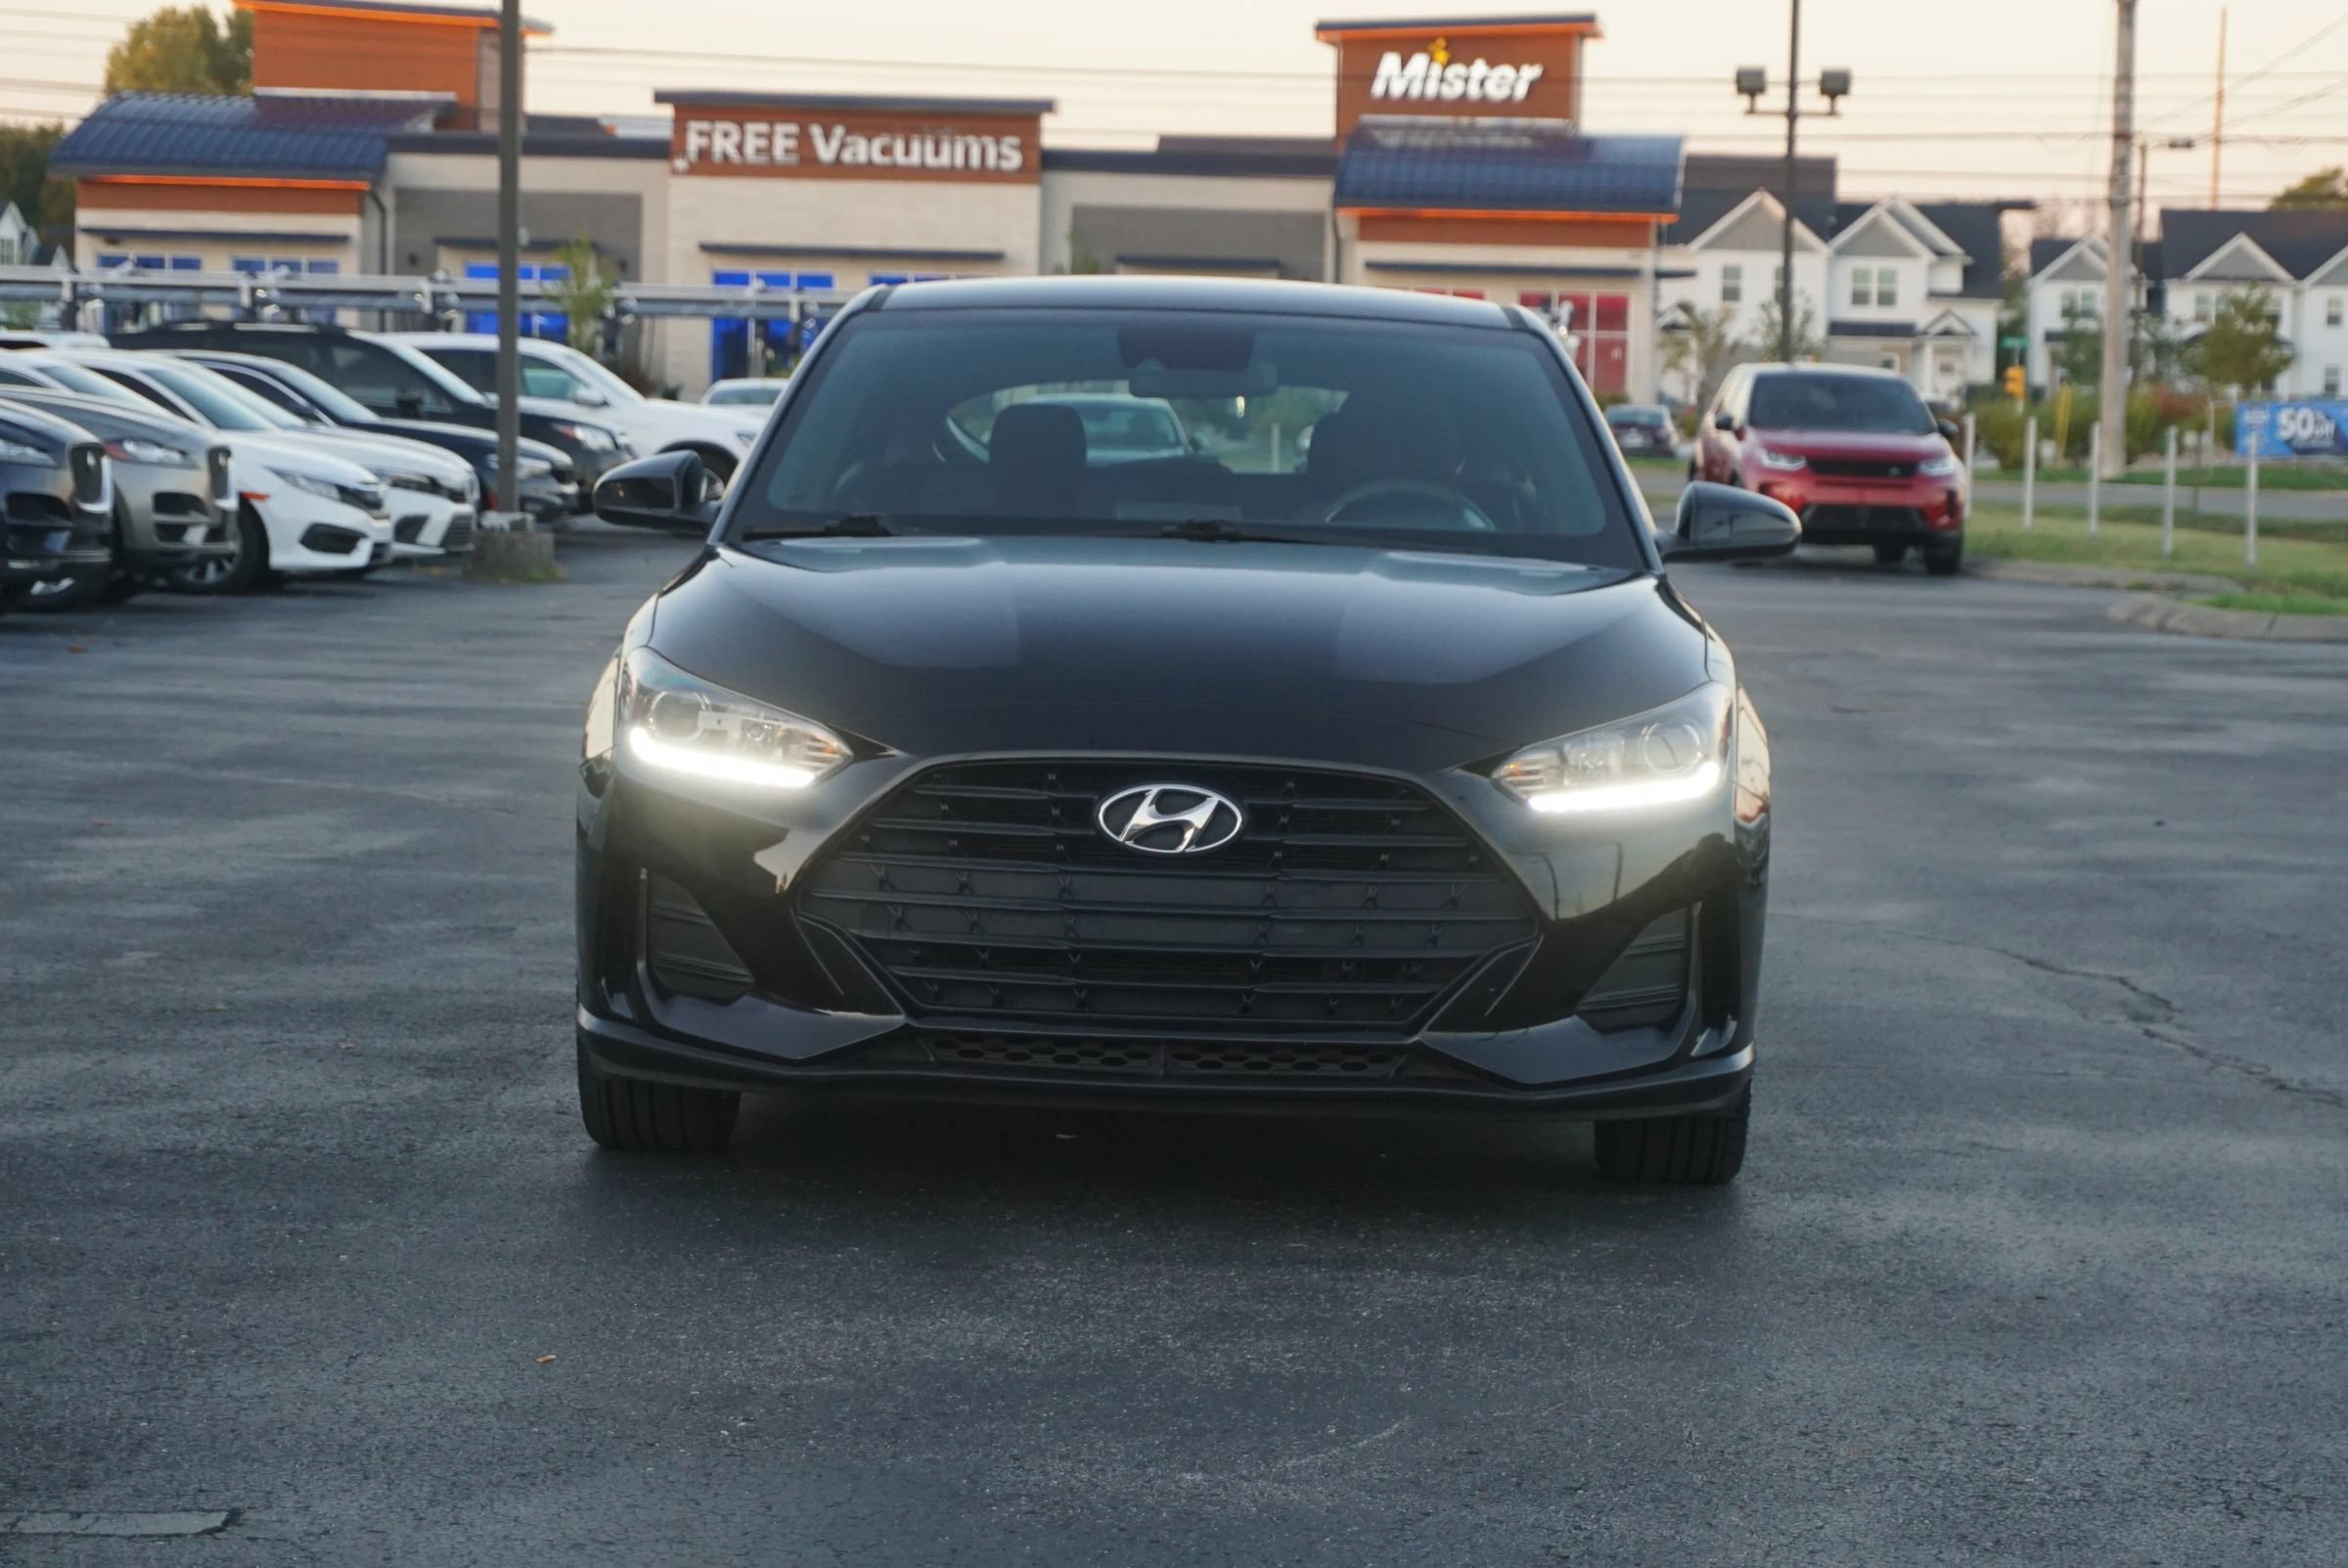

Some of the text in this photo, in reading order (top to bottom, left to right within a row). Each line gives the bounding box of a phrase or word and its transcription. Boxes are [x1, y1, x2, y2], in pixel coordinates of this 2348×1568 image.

[1372, 52, 1543, 103] Mister
[686, 119, 1023, 171] FREE Vacuums
